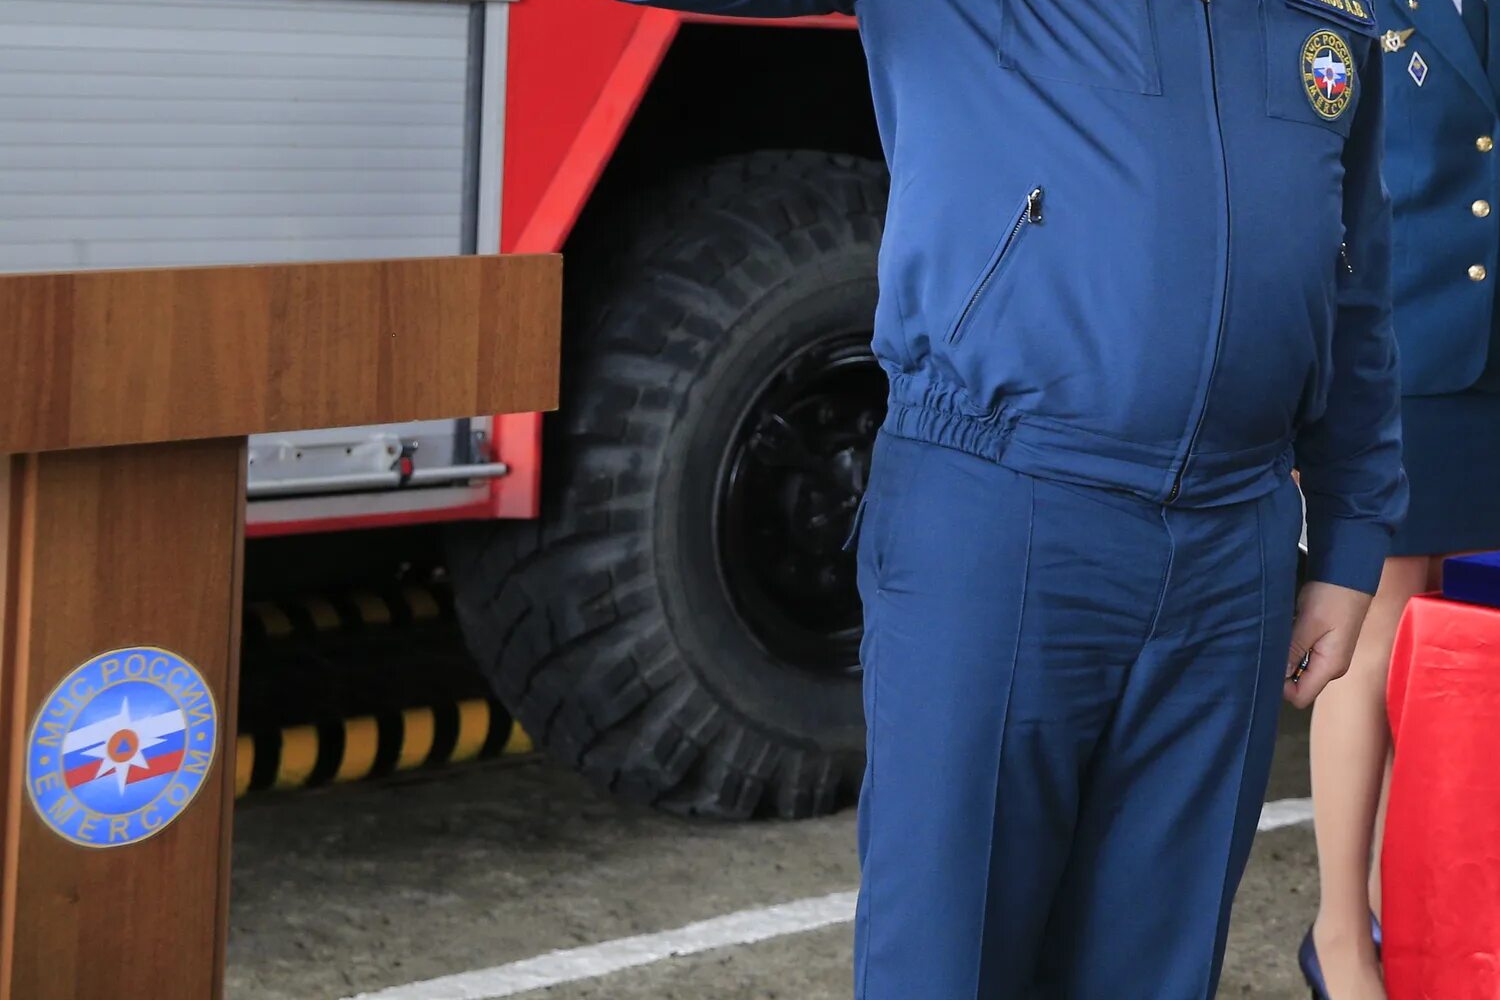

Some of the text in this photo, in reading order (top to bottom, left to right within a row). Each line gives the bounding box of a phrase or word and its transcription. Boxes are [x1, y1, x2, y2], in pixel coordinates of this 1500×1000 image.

[1305, 35, 1352, 76] МЧС РОССИИ
[1304, 72, 1351, 113] EMERCOM
[38, 654, 212, 747] МЧС РОССИИ
[35, 751, 210, 842] EMERCOM
